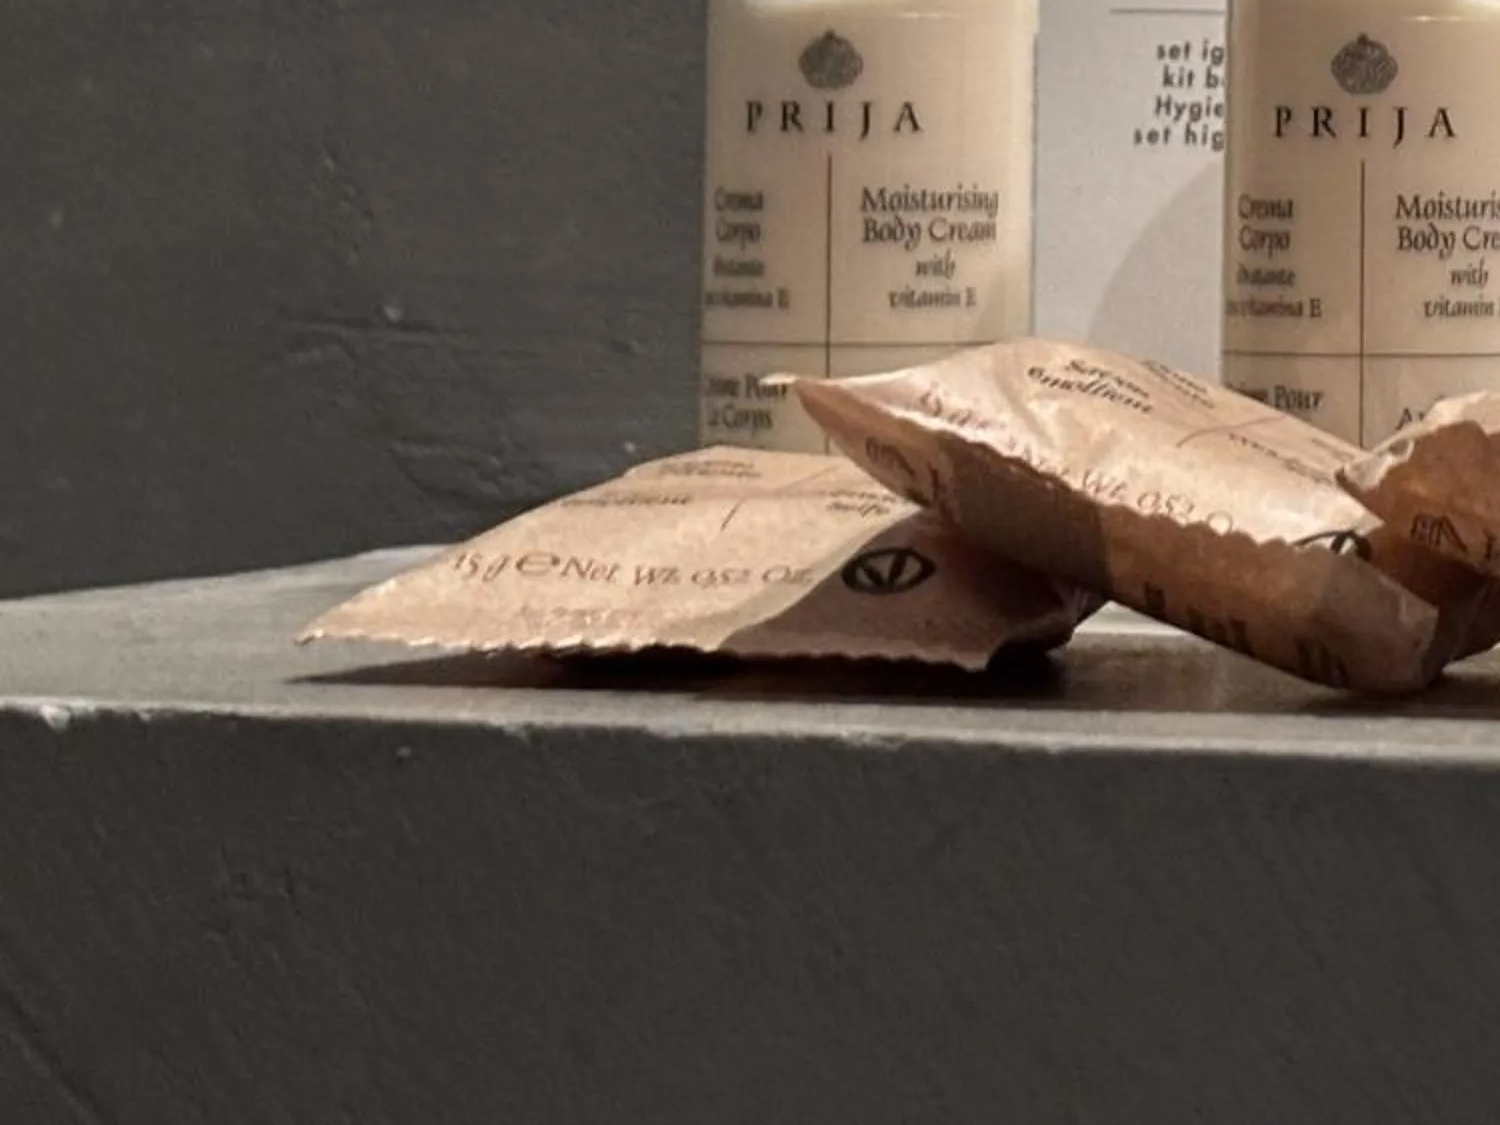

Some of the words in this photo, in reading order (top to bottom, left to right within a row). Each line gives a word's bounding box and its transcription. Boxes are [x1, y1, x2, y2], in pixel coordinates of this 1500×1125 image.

[1156, 41, 1192, 61] set
[1162, 64, 1195, 88] kit
[745, 100, 924, 139] PRIJA
[1133, 127, 1172, 146] set
[1273, 105, 1457, 148] PRIJA
[861, 181, 999, 219] Moisturising
[862, 215, 922, 252] Body
[928, 217, 997, 244] Cream
[1396, 222, 1456, 260] Body
[1450, 255, 1489, 289] with
[965, 286, 977, 309] E
